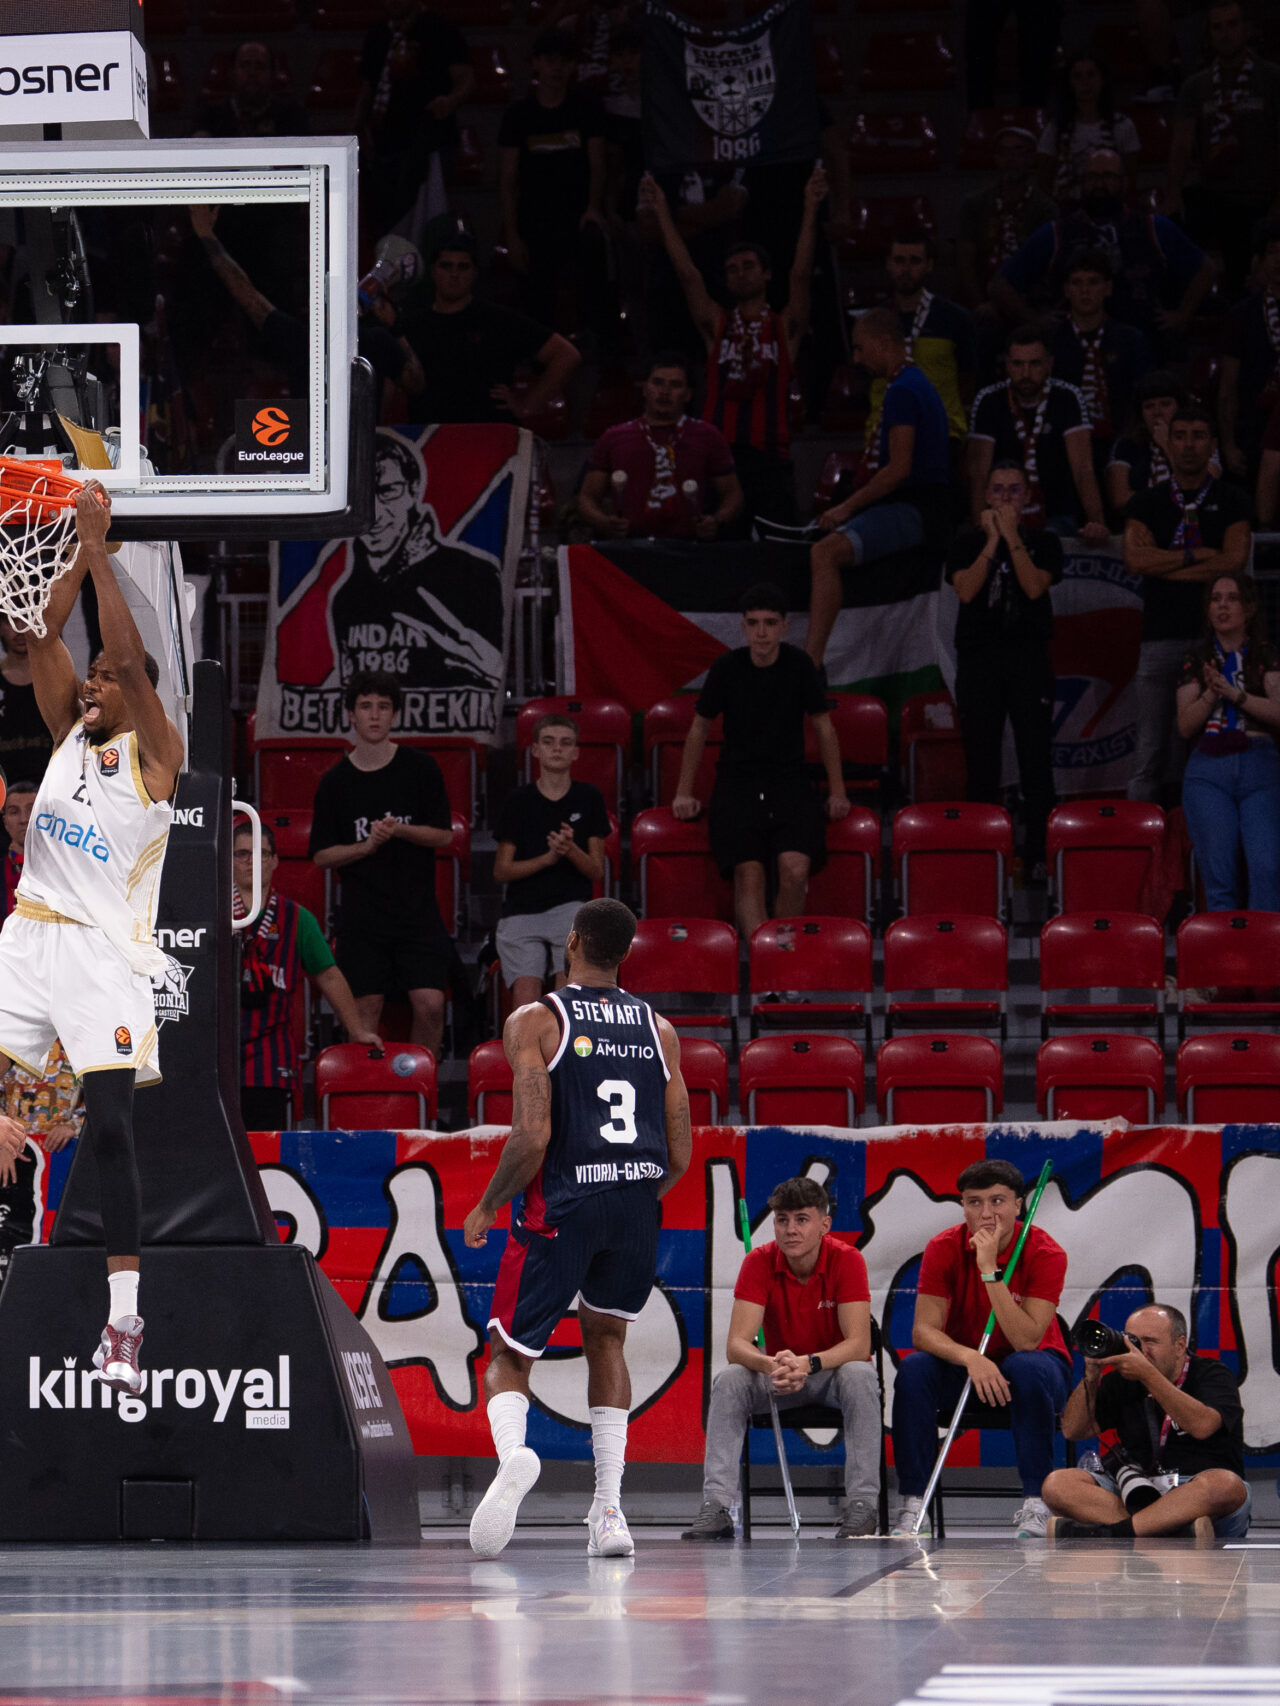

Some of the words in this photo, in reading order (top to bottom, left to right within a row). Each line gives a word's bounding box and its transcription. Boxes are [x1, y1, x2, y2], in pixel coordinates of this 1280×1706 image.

[712, 132, 762, 162] 1986
[237, 449, 304, 464] EuroLeague
[356, 649, 410, 674] 1986
[572, 999, 642, 1026] STEWART
[595, 1043, 655, 1060] AMUTIO
[596, 1079, 639, 1145] 3
[252, 1414, 287, 1428] media
